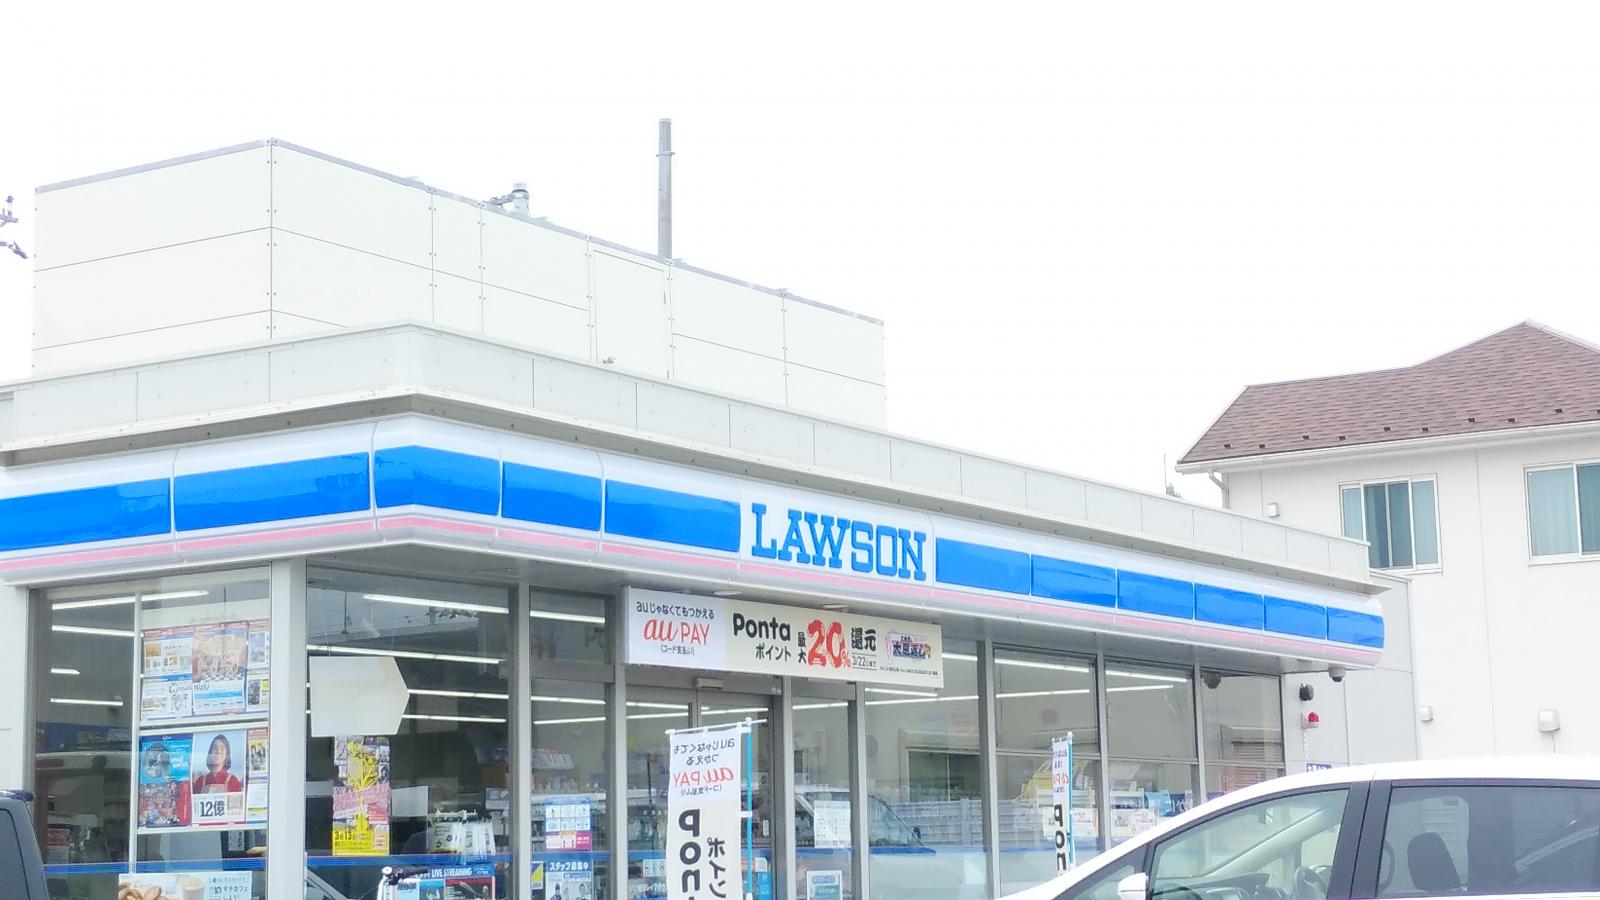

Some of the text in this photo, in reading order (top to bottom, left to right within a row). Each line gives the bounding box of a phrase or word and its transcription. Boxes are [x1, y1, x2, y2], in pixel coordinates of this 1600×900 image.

[752, 502, 926, 581] LAWSON
[636, 601, 715, 620] auじゃなくてもつかえる
[643, 618, 710, 646] au PAY
[732, 612, 791, 642] Ponta
[850, 627, 877, 652] 還元
[755, 643, 791, 663] ポイント
[807, 619, 851, 668] 20%
[200, 800, 225, 818] 12億
[431, 869, 443, 877] LIVE
